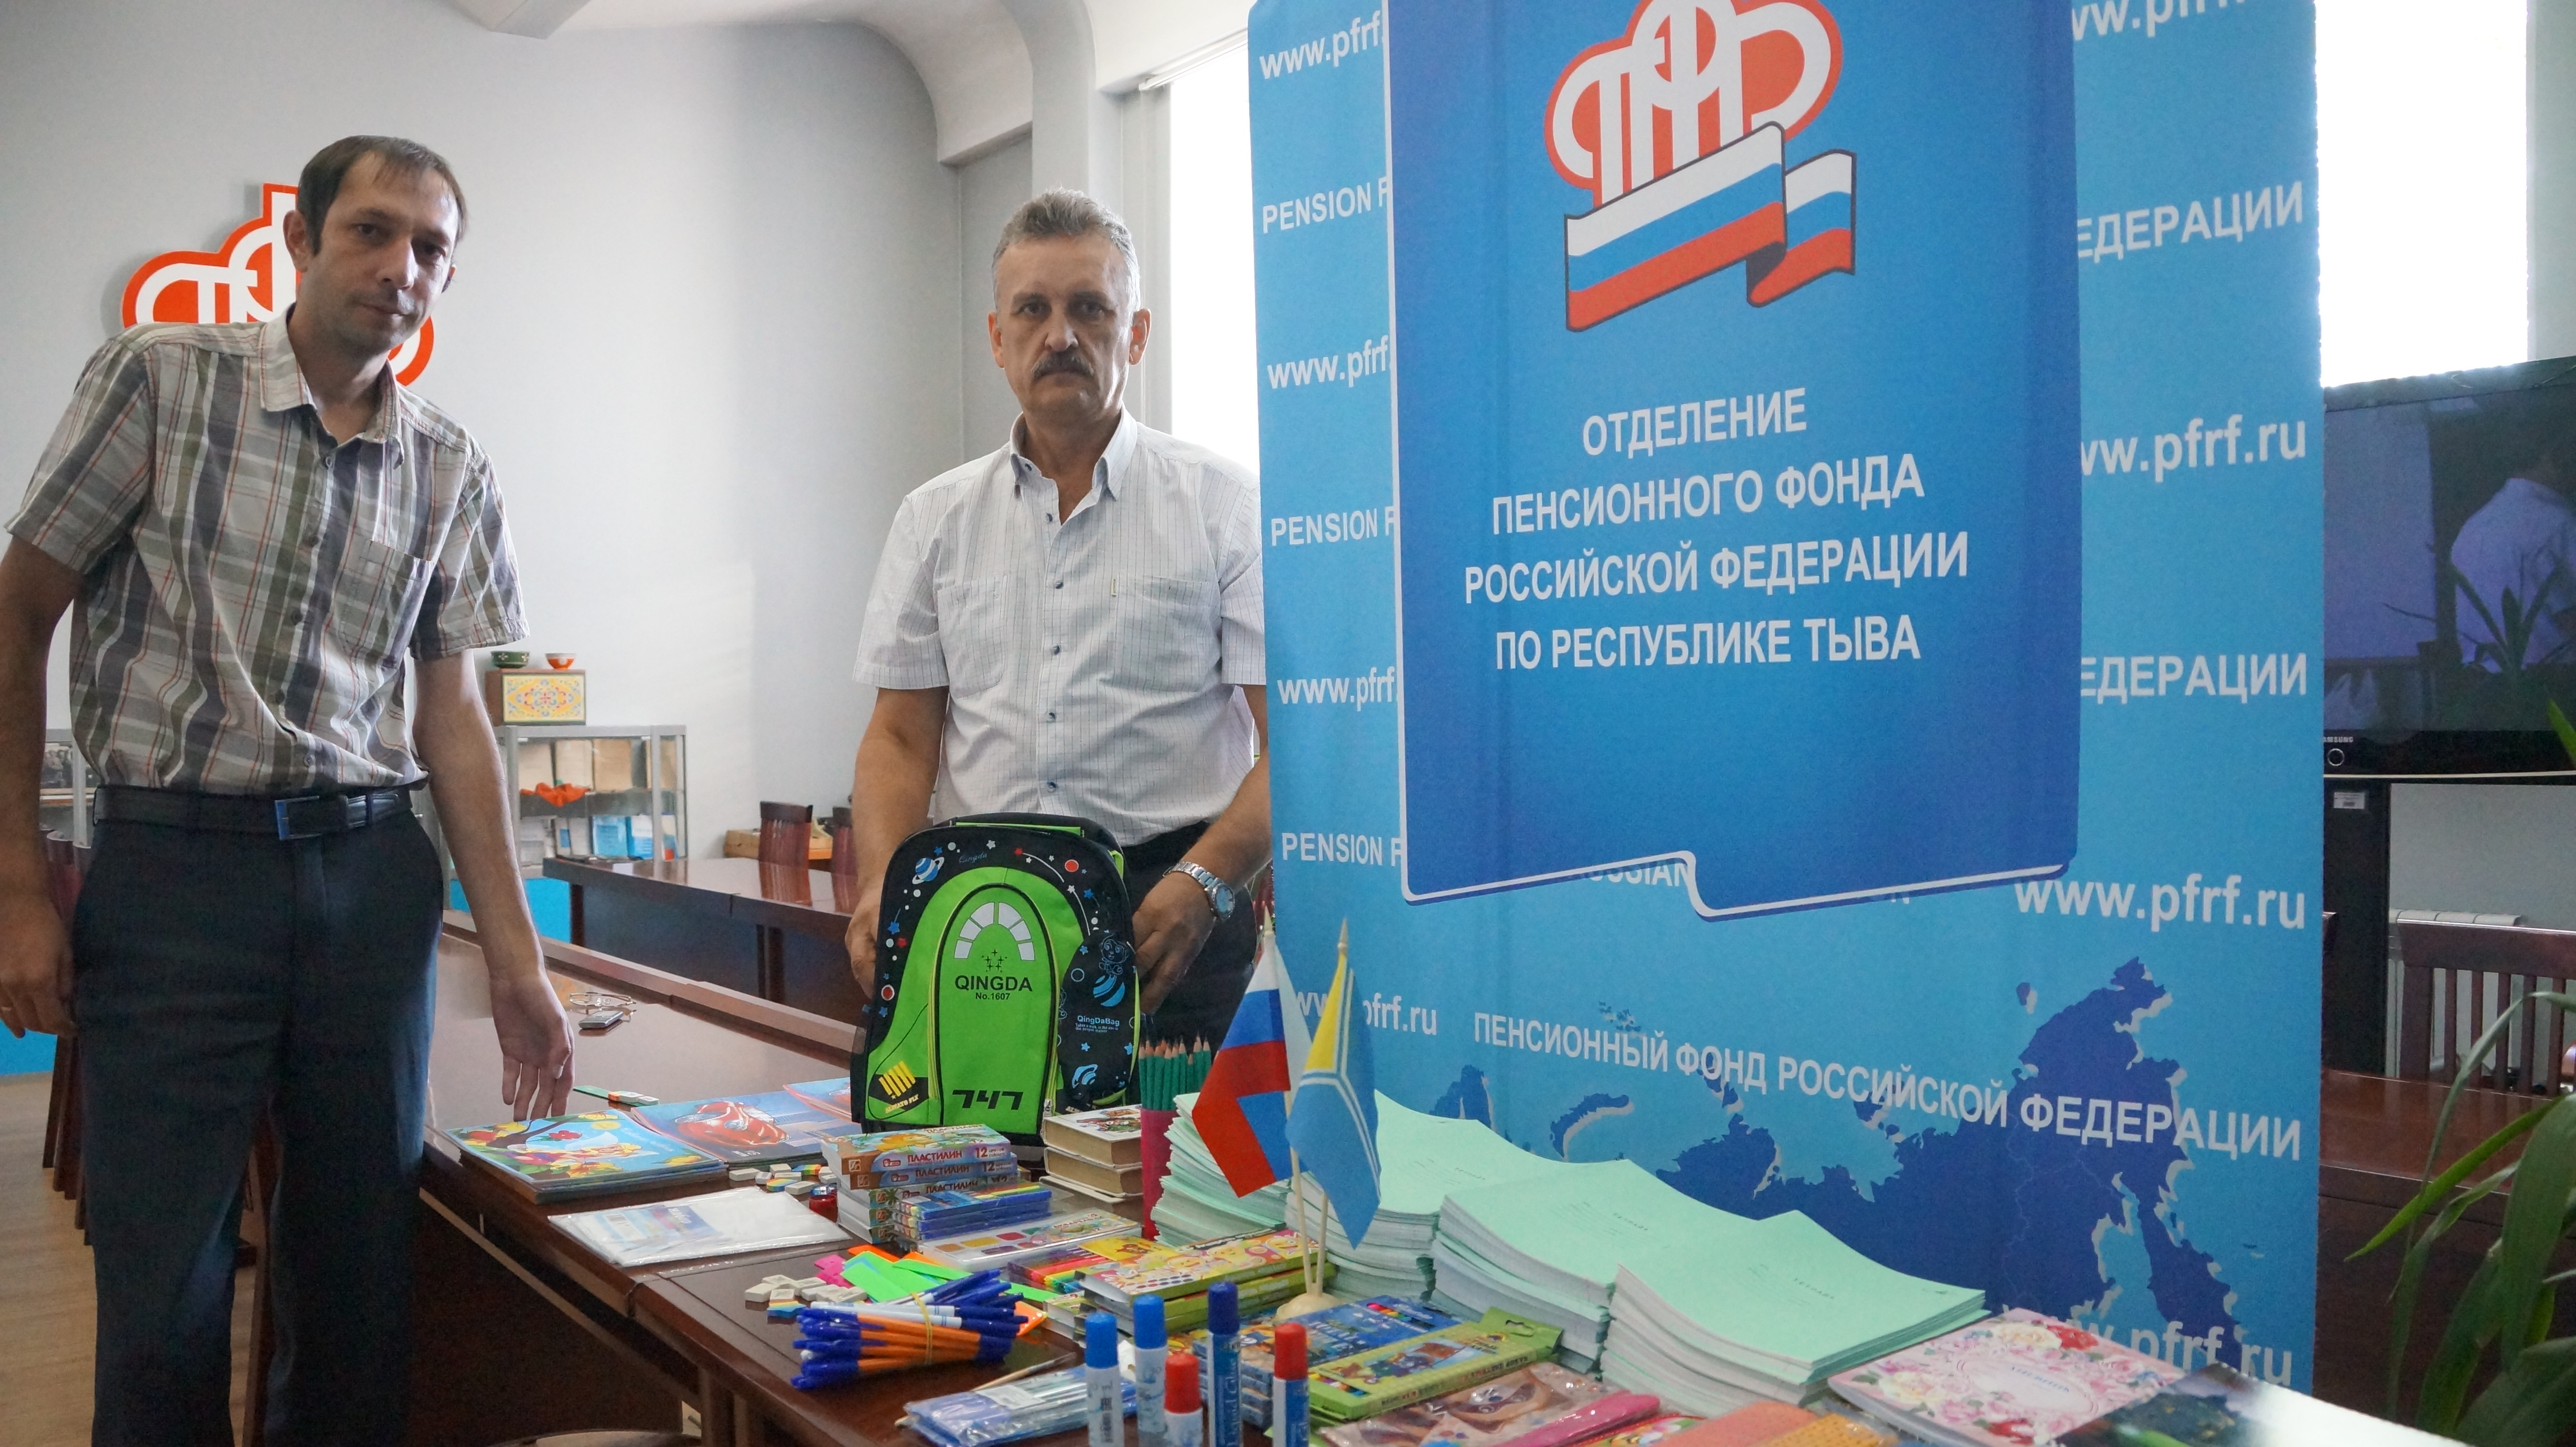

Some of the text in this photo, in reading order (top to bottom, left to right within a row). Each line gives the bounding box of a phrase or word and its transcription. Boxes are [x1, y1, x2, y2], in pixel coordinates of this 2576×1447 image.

[1259, 9, 1383, 80] www.pfrf
[1262, 182, 1371, 234] PENSION
[2077, 181, 2303, 264] ЕДЕРАЦИИ
[1266, 334, 1390, 390] www.pfrf
[1583, 387, 1807, 459] ОТДЕЛЕНИЕ
[1493, 453, 1925, 535] ПЕНСИОННОГО ФОНДА
[1271, 508, 1378, 546] PENSION
[1466, 532, 1968, 603] РОССИЙСКОЙ ФЕДЕРАЦИИ
[1497, 614, 1920, 669] ПО РЕСПУБЛИКЕ ТЫВА
[1278, 666, 1397, 711] www.pfrf
[2080, 653, 2306, 704] ЕДЕРАЦИИ
[1282, 833, 1382, 866] PENSION
[2014, 873, 2304, 932] www.pfrf.ru
[954, 975, 1033, 992] QINGDA
[975, 992, 1011, 1001] No.1607
[1077, 1015, 1120, 1027] QingDaBag
[952, 1089, 1024, 1110] 747
[1475, 1012, 2300, 1161] ПЕНСИОННЫЙ ФОНД РОССИЙСКОЙ ФЕДЕРАЦИИ
[907, 1150, 962, 1163] ПЛАСТИЛИН
[975, 1147, 988, 1159] 12
[915, 1165, 970, 1178] ПЛАСТИЛИН
[982, 1161, 995, 1172] 12
